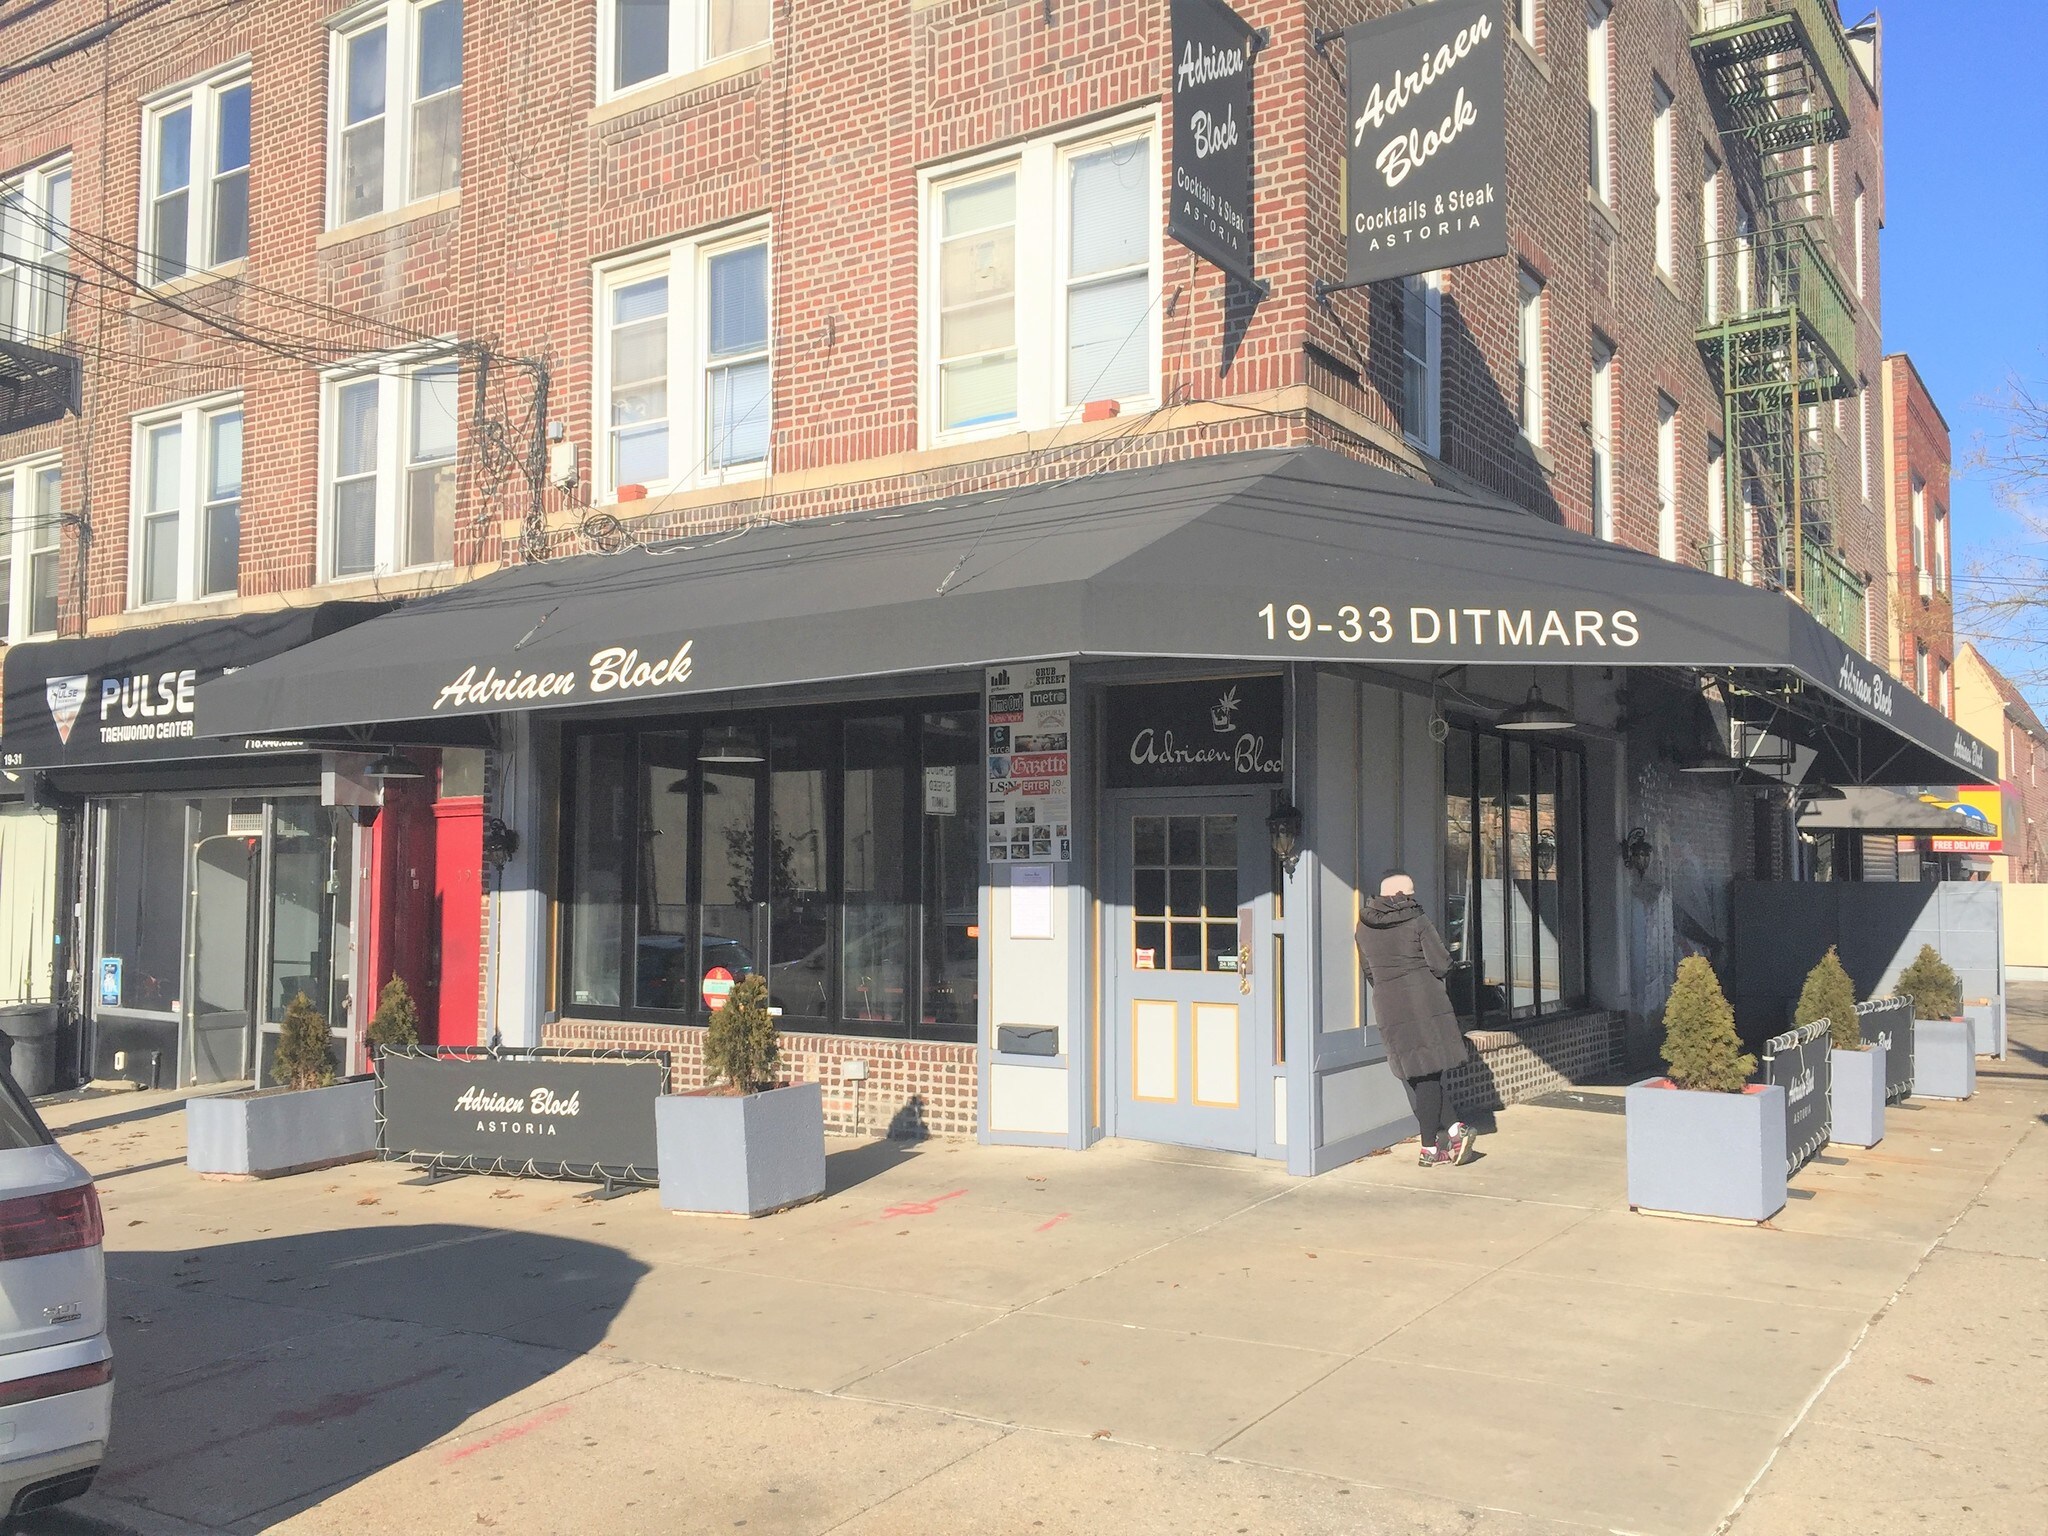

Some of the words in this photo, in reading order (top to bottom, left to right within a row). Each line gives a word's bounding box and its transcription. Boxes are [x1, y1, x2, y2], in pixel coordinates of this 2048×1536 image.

[1177, 40, 1243, 93] Adriaen
[1355, 14, 1492, 147] Adriaen
[1190, 103, 1238, 158] Block
[1376, 86, 1477, 187] Block
[1177, 166, 1216, 211] Cocktails
[1218, 196, 1223, 218] &
[1223, 200, 1245, 233] Steak
[1355, 200, 1427, 233] Cocktails
[1434, 194, 1444, 215] &
[1448, 183, 1494, 211] Steak
[1183, 201, 1237, 250] ASTORIA
[1369, 215, 1480, 251] ASTORIA
[1258, 603, 1394, 643] 19-33
[1409, 606, 1640, 647] DITMARS
[432, 665, 575, 710] Adriaen
[589, 640, 693, 693] Block
[1035, 667, 1056, 676] GRUB
[1035, 674, 1066, 685] STREET
[1838, 653, 1872, 705] Adriaen
[1873, 673, 1893, 717] Block
[100, 669, 196, 720] PULSE
[1032, 691, 1066, 703] metro
[100, 726, 154, 744] TAEKWONDO
[156, 720, 194, 739] CENTER
[1130, 728, 1230, 764] Adriaen
[1235, 733, 1284, 773] Bloc
[3, 753, 23, 766] 19-31
[1011, 756, 1067, 777] Gazette
[1023, 781, 1049, 791] EATER
[1933, 841, 1952, 850] FREE
[1954, 841, 1990, 850] DELIVERY
[454, 1085, 524, 1113] Adriaen
[529, 1087, 580, 1116] Block
[476, 1121, 556, 1135] ASTORIA
